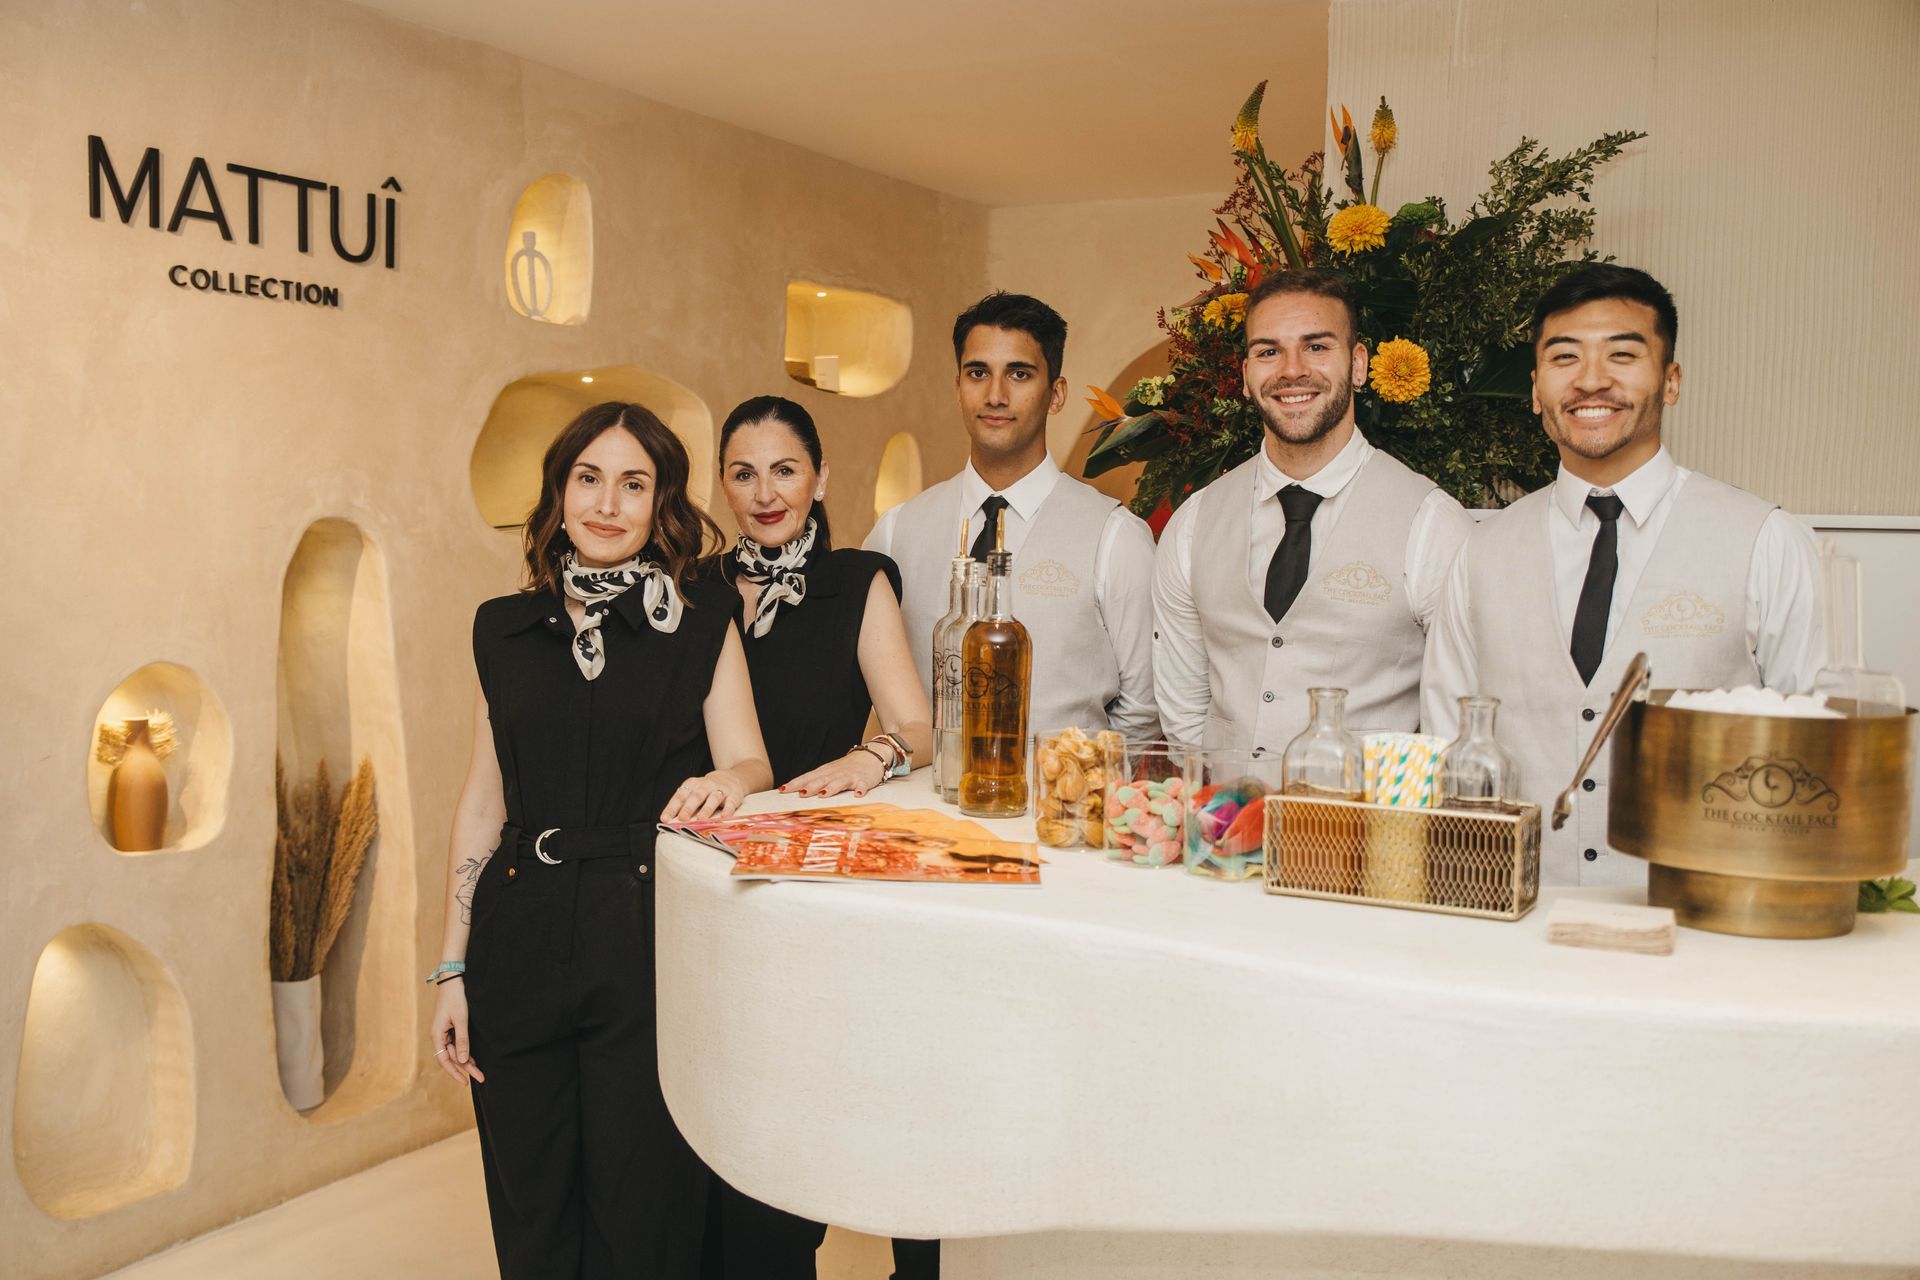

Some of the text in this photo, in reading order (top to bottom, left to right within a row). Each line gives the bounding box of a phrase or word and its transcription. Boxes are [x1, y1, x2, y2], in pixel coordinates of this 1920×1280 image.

[88, 134, 402, 269] MATTUÎ
[168, 264, 339, 307] COLLECTION
[1703, 807, 1838, 827] THE COCKTAIL FACE
